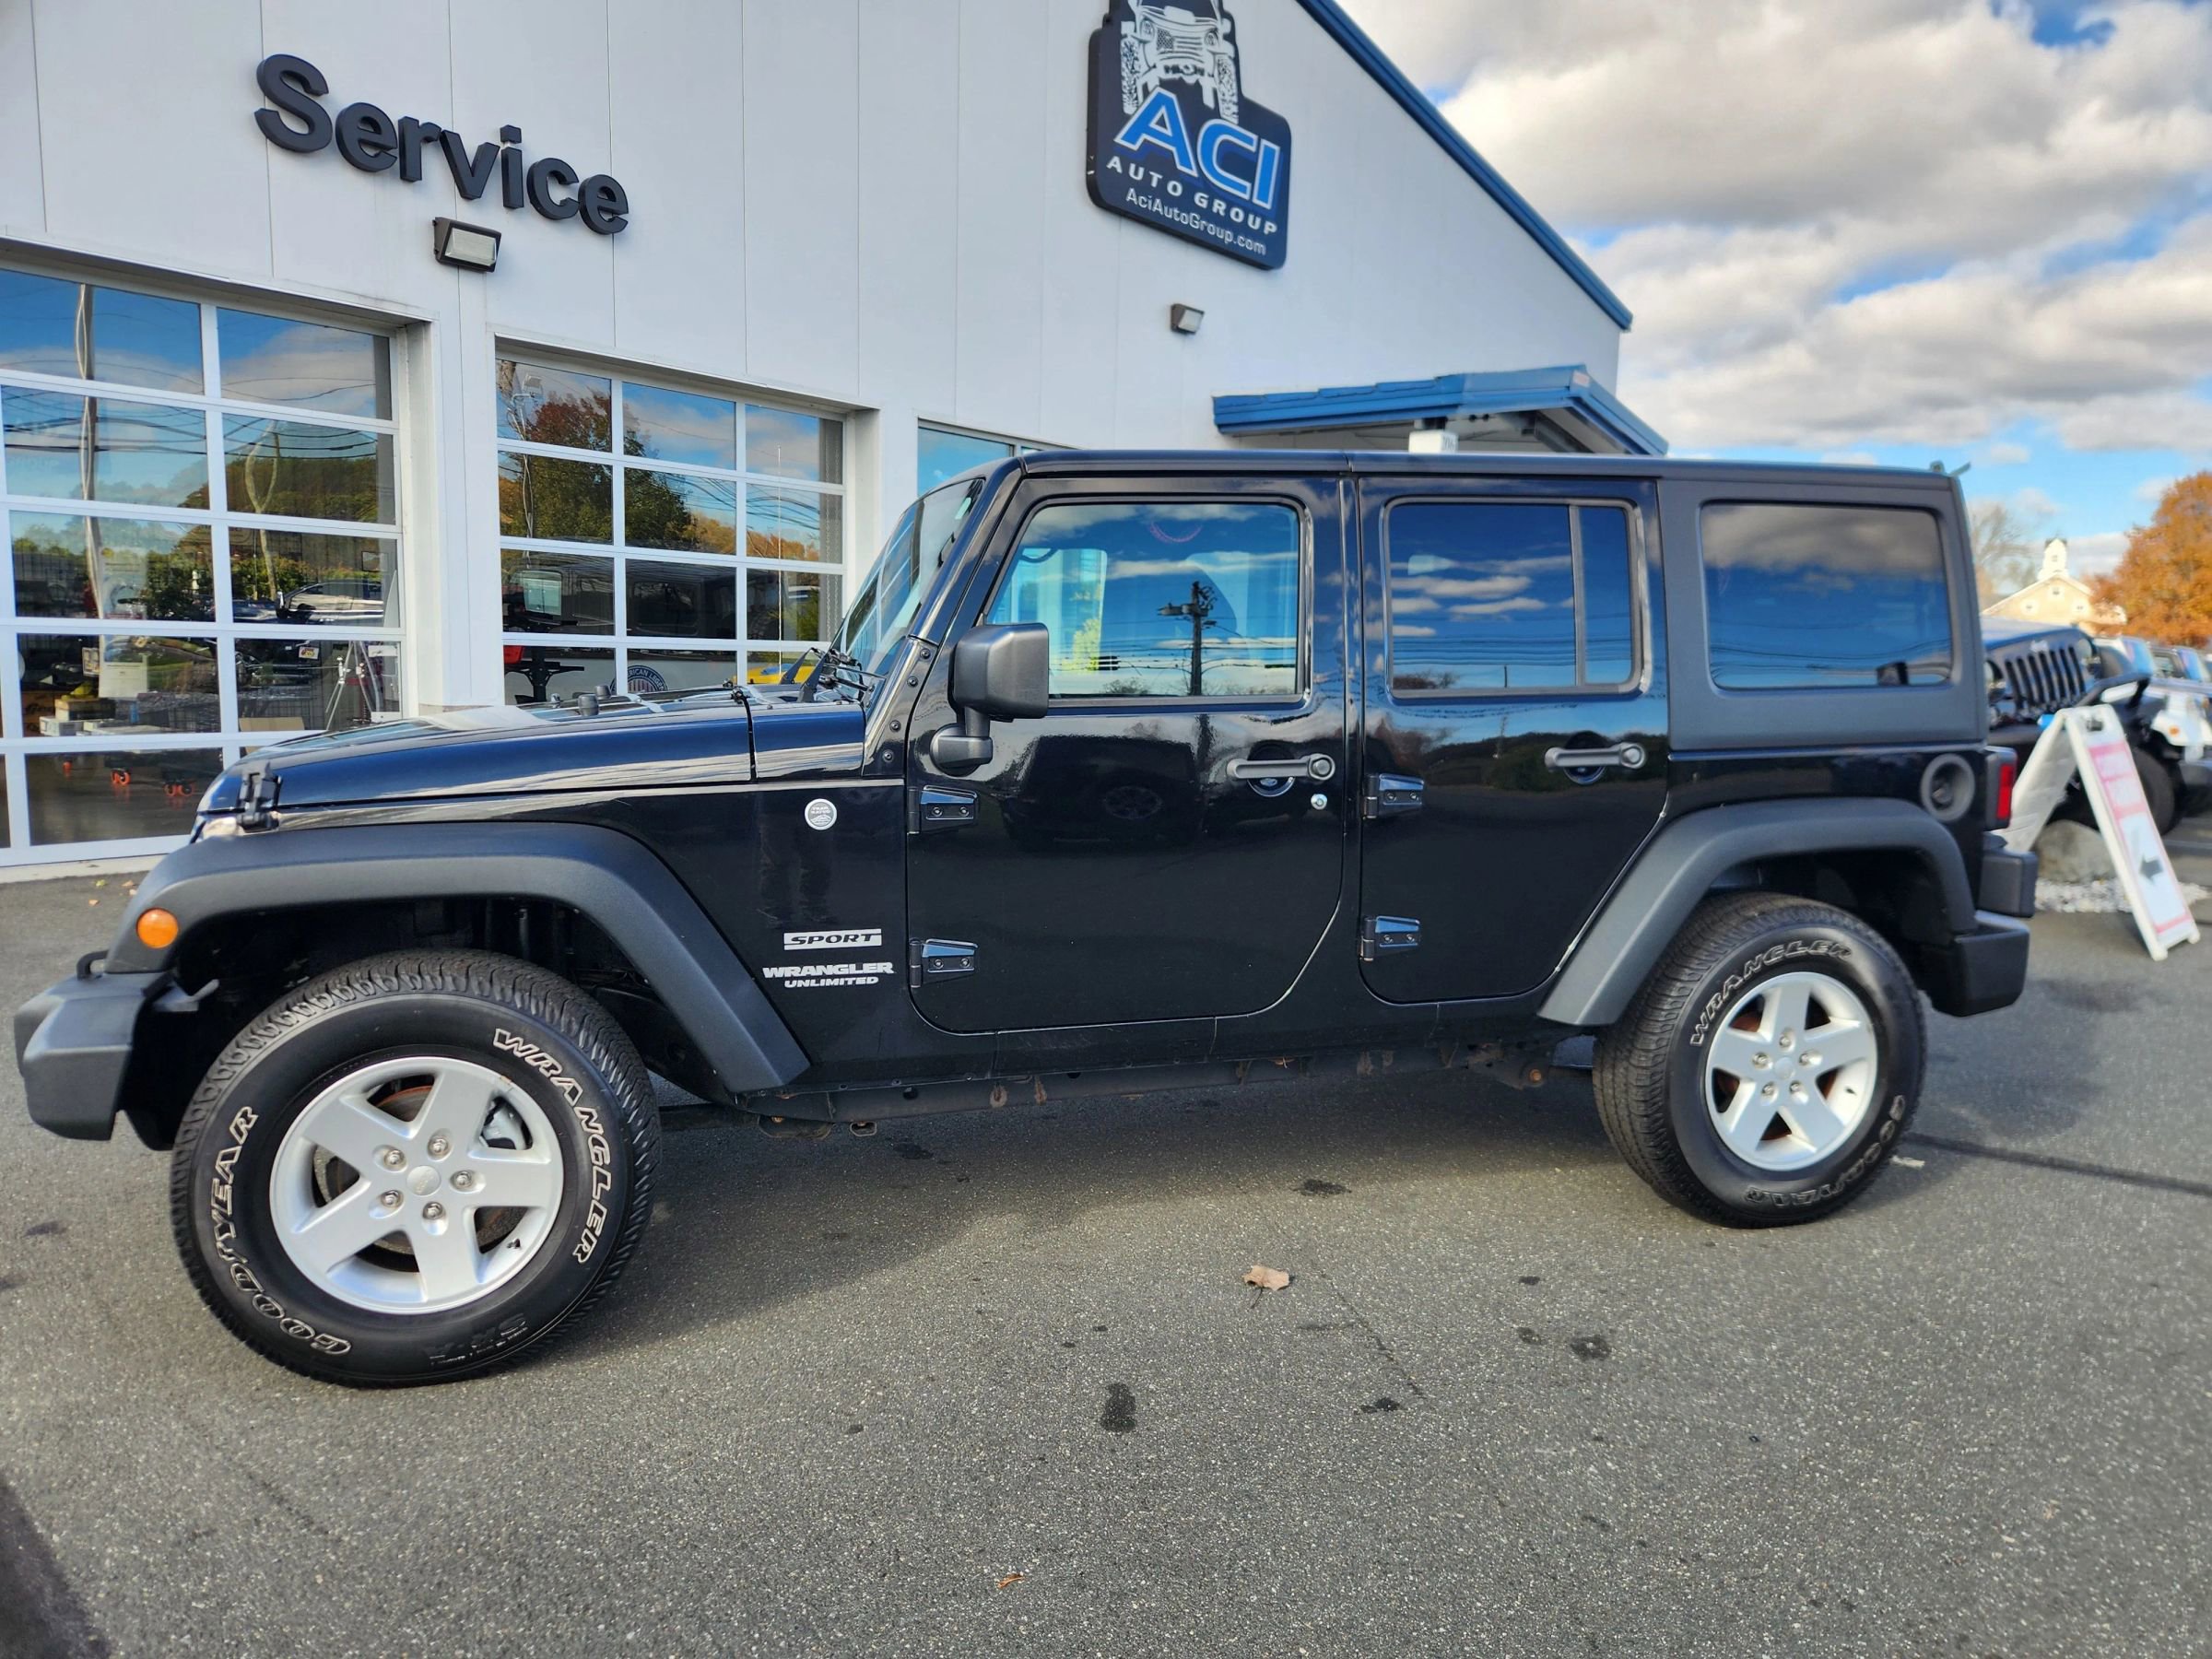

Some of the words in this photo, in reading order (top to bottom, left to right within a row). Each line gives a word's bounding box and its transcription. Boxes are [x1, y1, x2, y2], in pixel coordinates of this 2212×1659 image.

[254, 53, 629, 236] Service
[1113, 85, 1280, 210] ACI
[1106, 156, 1182, 197] AUTO
[1194, 192, 1277, 235] GROUP
[1125, 187, 1266, 256] AciAutoGroup.com
[762, 961, 894, 979] WRANGLER
[783, 977, 879, 989] UNLIMITED
[789, 932, 877, 946] SPORT
[1689, 939, 1853, 1047] WRANGLER
[494, 1028, 612, 1265] WRANGLER
[210, 1106, 352, 1355] GOODYEAR
